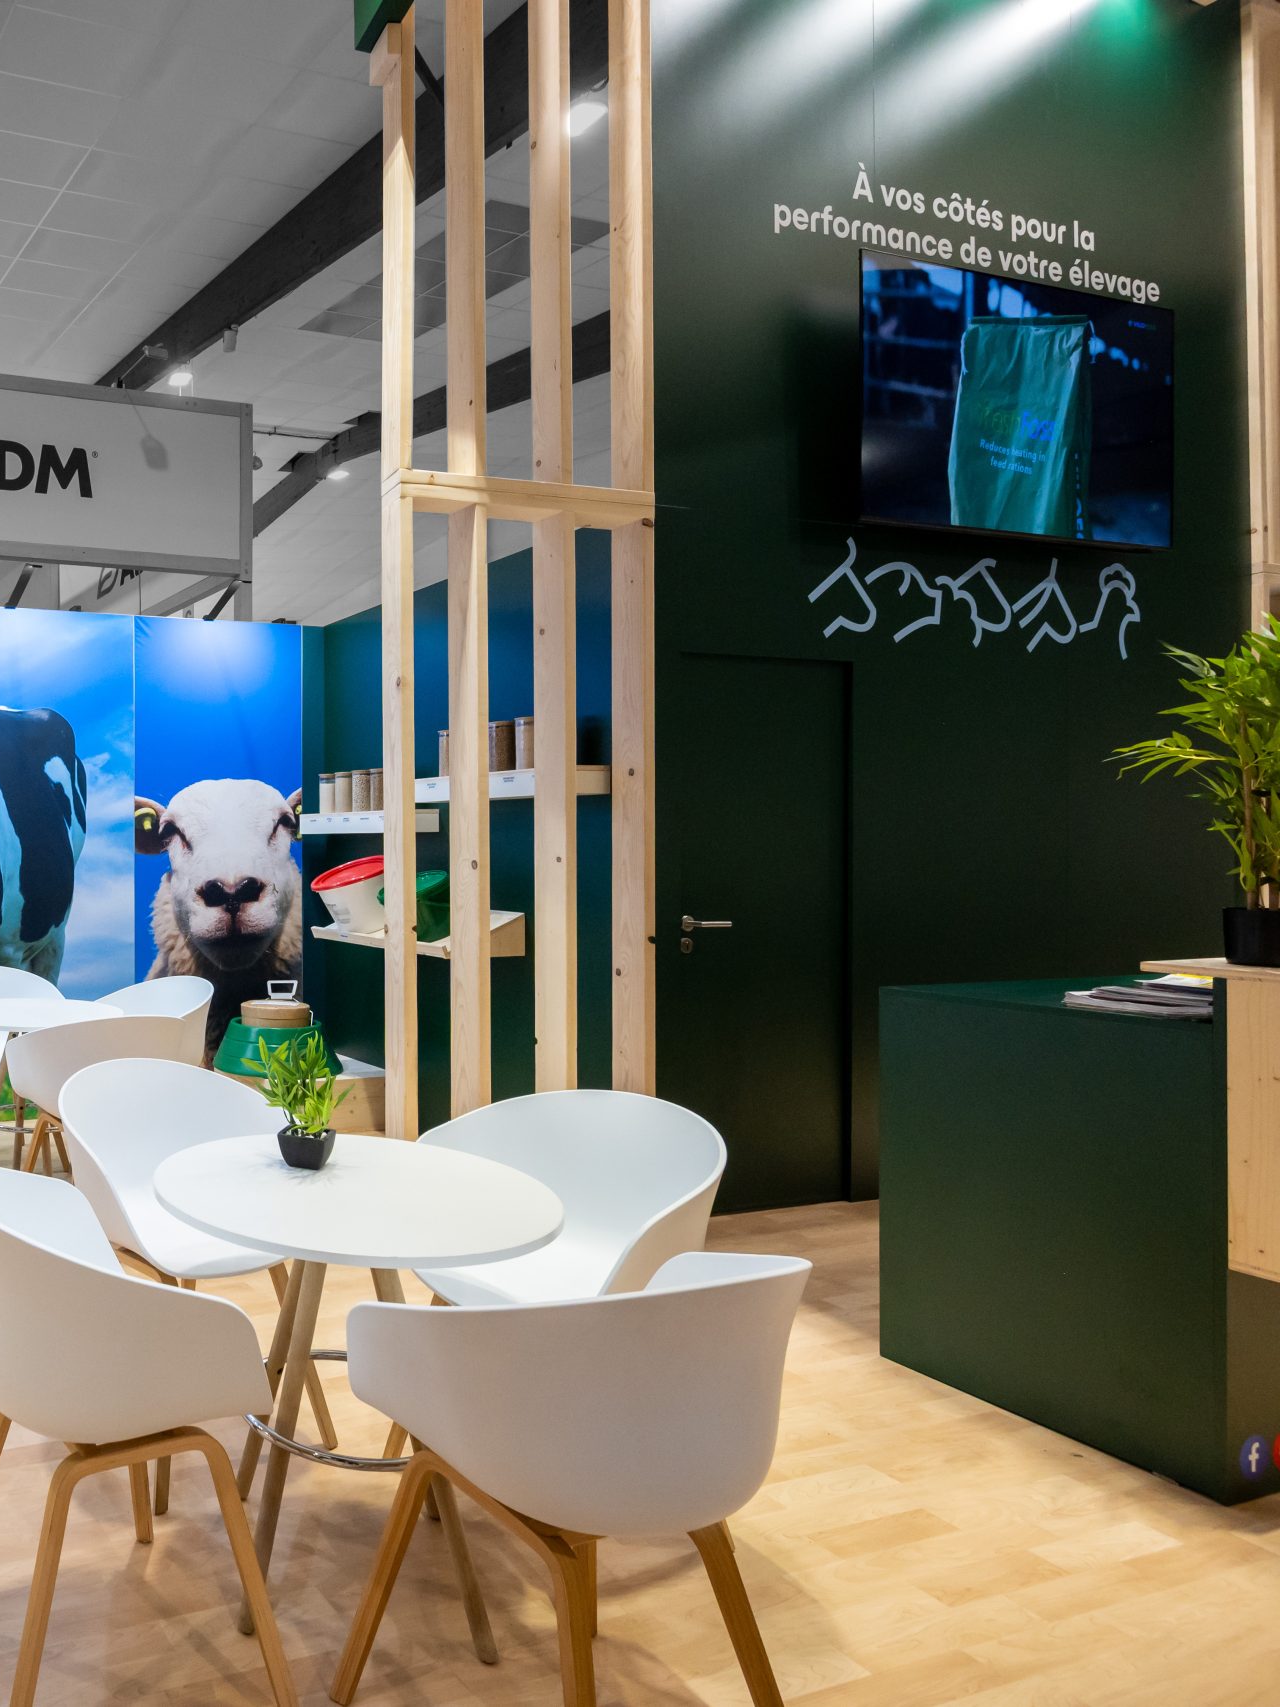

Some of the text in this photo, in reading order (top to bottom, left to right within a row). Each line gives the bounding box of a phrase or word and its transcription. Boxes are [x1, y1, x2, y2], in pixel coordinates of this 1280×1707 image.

[773, 203, 1160, 304] performance de votre élevage
[852, 161, 1095, 252] À vos côtés pour la
